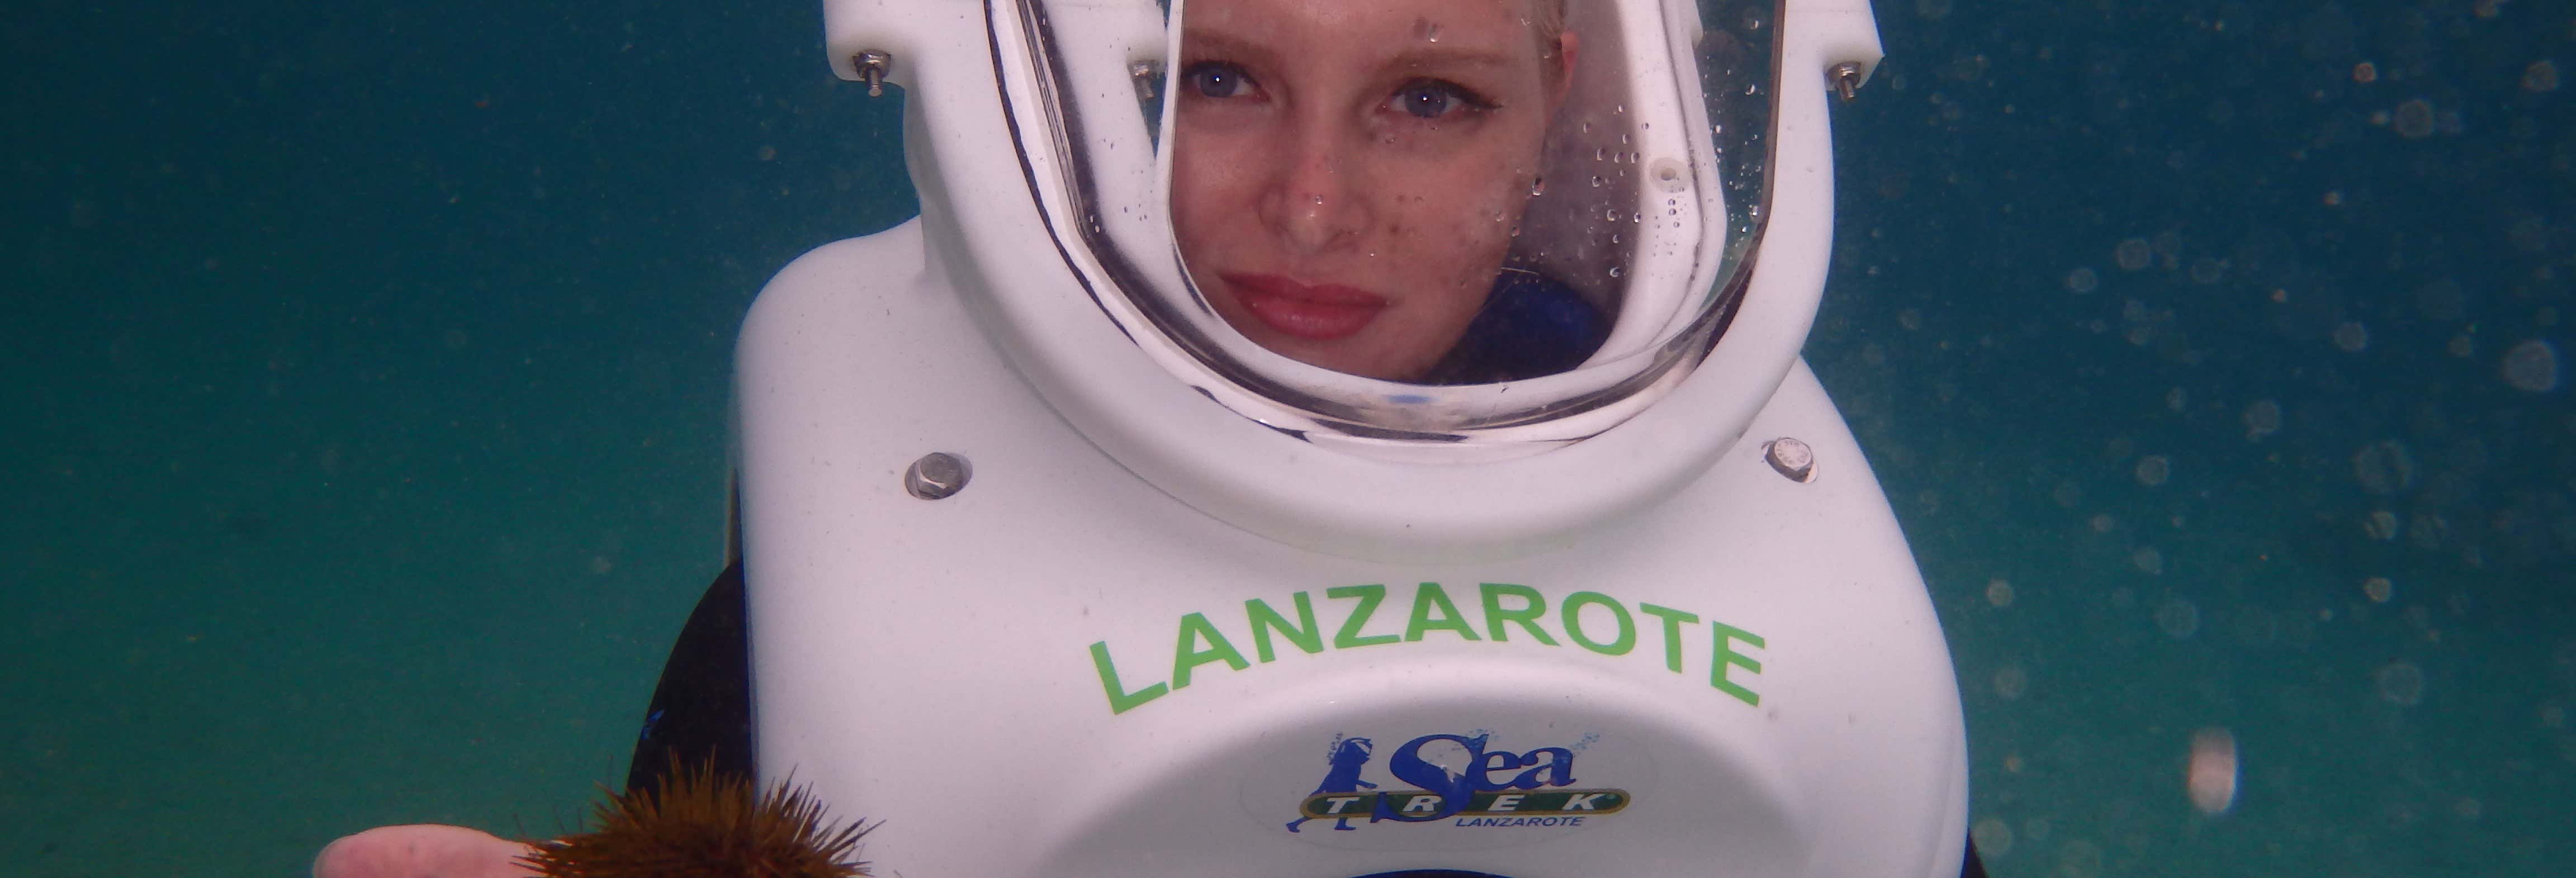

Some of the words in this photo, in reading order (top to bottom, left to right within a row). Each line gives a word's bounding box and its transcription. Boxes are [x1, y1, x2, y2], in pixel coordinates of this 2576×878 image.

[1090, 582, 1765, 714] LANZAROTE
[1326, 794, 1605, 814] TREK
[1370, 734, 1576, 823] Sea
[1456, 817, 1585, 827] LANZAROTE
